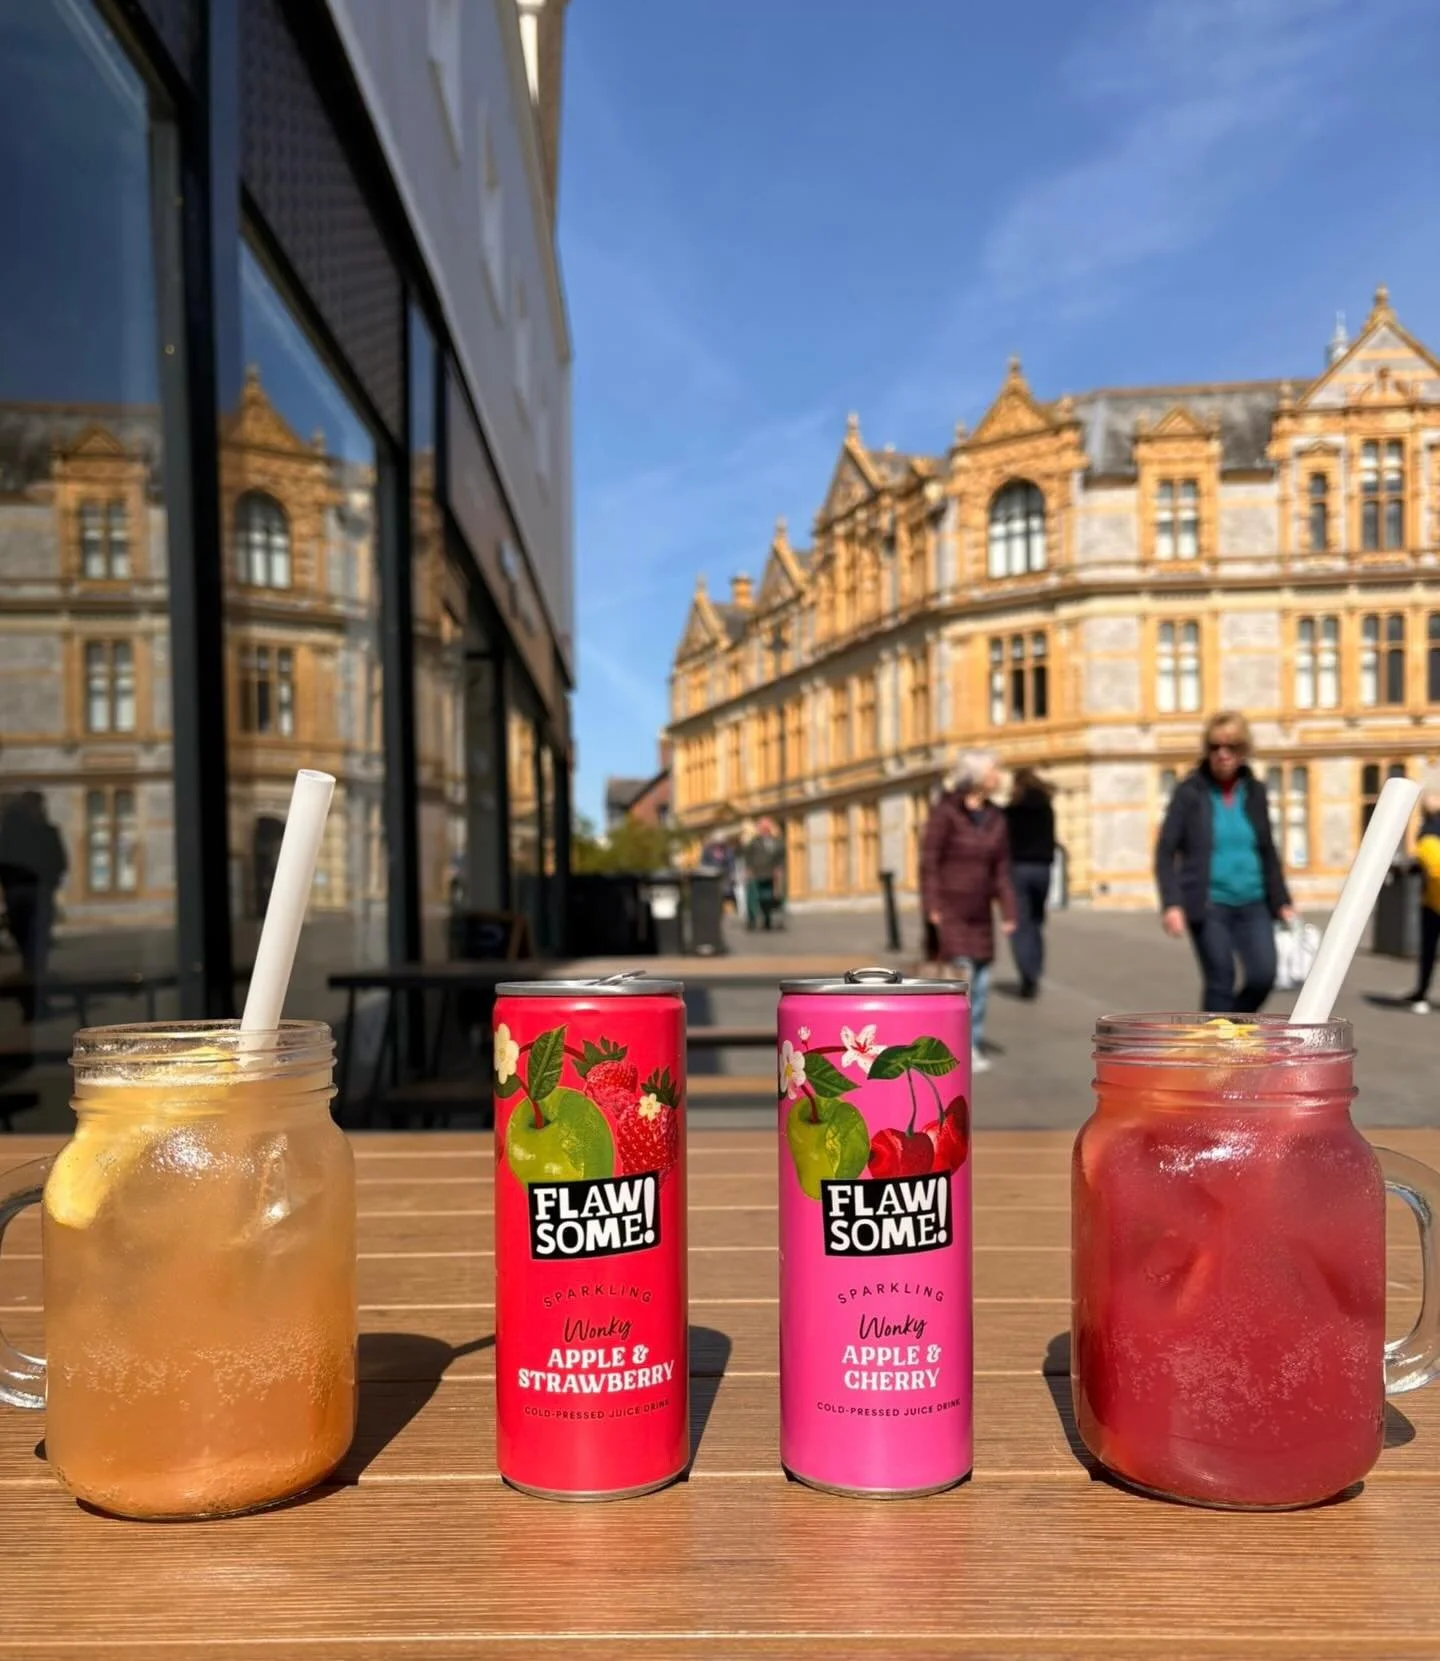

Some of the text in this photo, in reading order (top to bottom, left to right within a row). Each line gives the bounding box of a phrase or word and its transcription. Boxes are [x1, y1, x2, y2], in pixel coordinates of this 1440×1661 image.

[534, 1178, 644, 1220] FLAW
[827, 1178, 937, 1217] FLAW
[543, 1285, 653, 1308] SPARKLING
[838, 1283, 945, 1304] SPARKLING
[564, 1316, 632, 1342] Wonky
[859, 1314, 927, 1339] Wonky
[547, 1344, 649, 1369] APPLE &
[842, 1343, 941, 1366] APPLE &
[518, 1359, 675, 1393] STRAWBERRY
[844, 1367, 940, 1391] CHERRY
[524, 1399, 669, 1420] COLD-PRESSED JUICE DRINK
[817, 1399, 961, 1417] COLD-PRESSED JUICE DRINK
